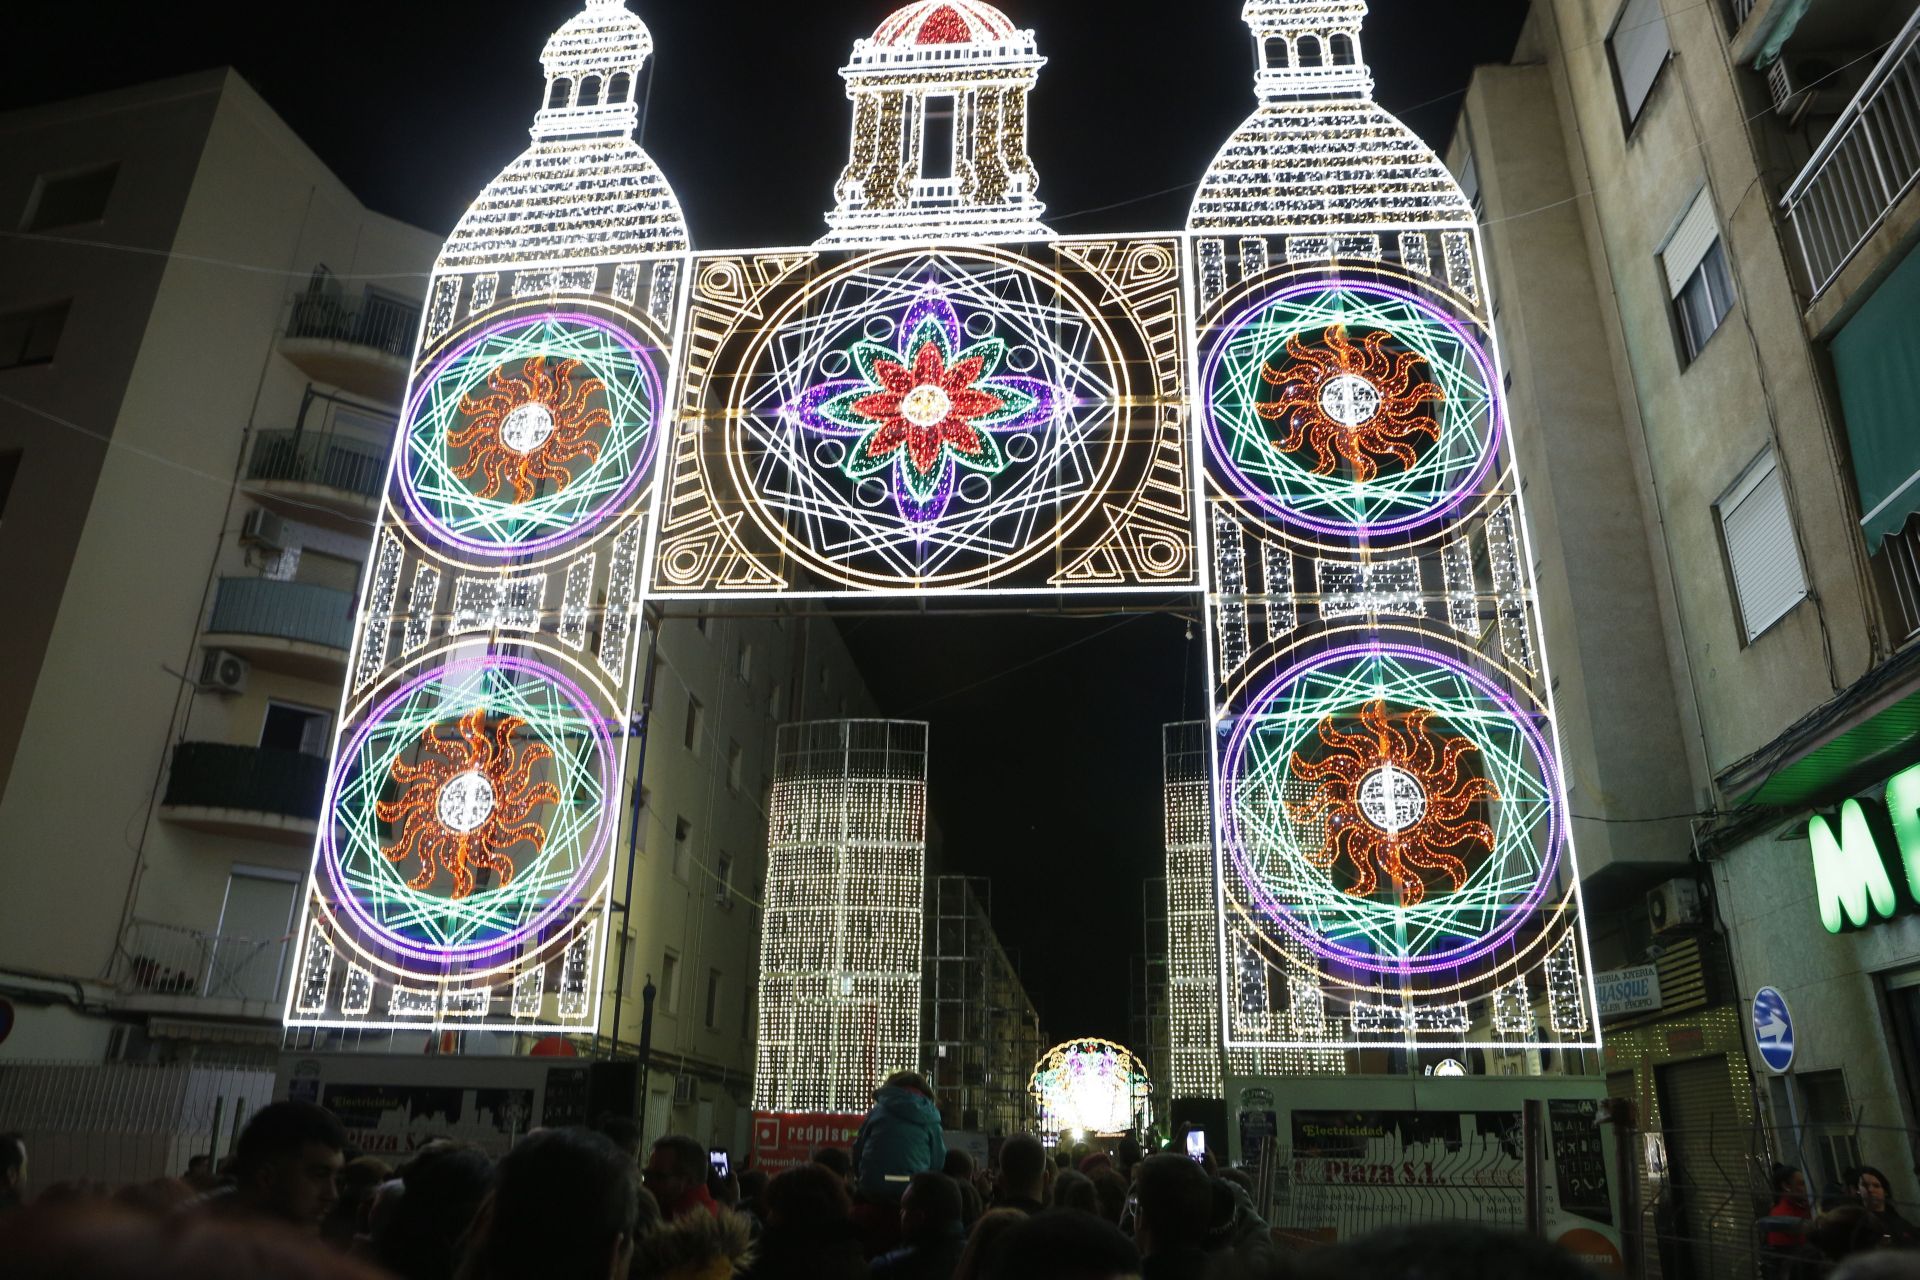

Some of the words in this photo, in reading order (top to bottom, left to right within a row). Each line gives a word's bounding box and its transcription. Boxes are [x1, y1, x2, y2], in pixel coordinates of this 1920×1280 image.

[1623, 968, 1655, 980] JOYERIA
[335, 1096, 400, 1108] Electricidad
[787, 1125, 849, 1143] redpiso
[1302, 1124, 1384, 1137] Electricidad
[1327, 1161, 1394, 1184] Plaza
